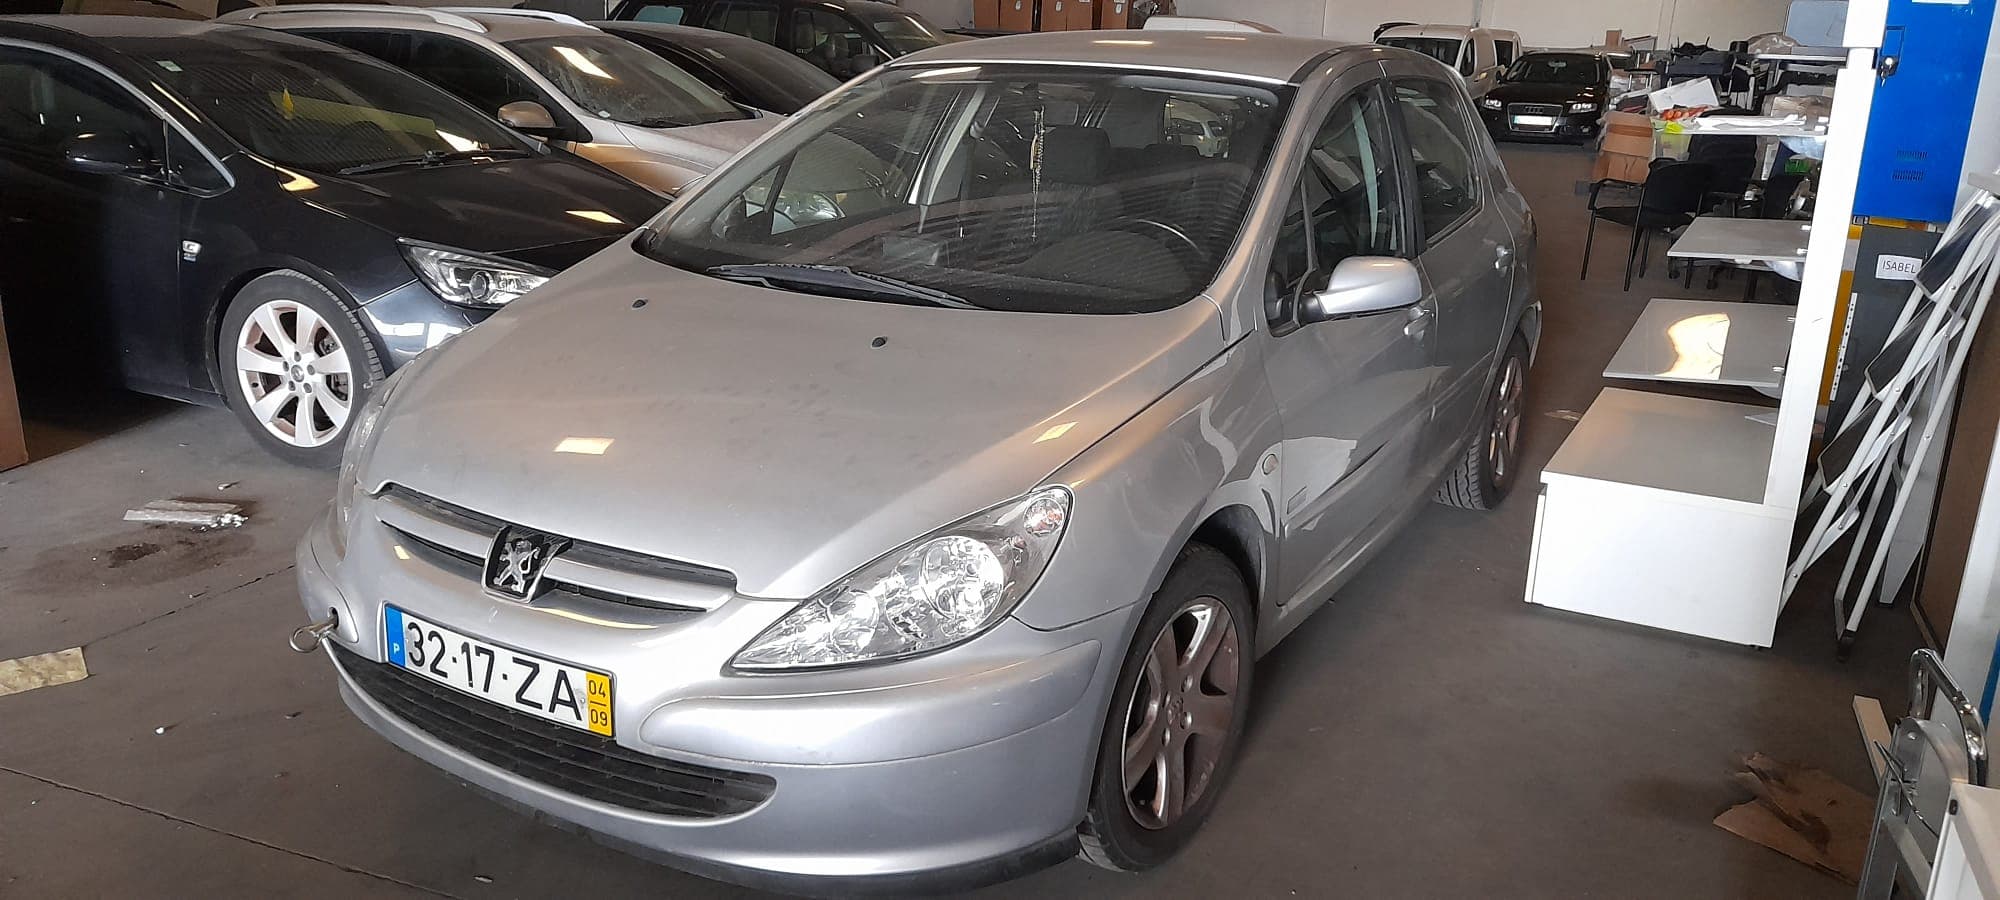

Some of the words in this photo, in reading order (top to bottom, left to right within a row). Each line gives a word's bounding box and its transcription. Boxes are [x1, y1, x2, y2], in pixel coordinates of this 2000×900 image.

[1882, 260, 1916, 273] ISABEL
[393, 642, 400, 655] P
[588, 680, 606, 698] 04
[590, 708, 608, 727] 09
